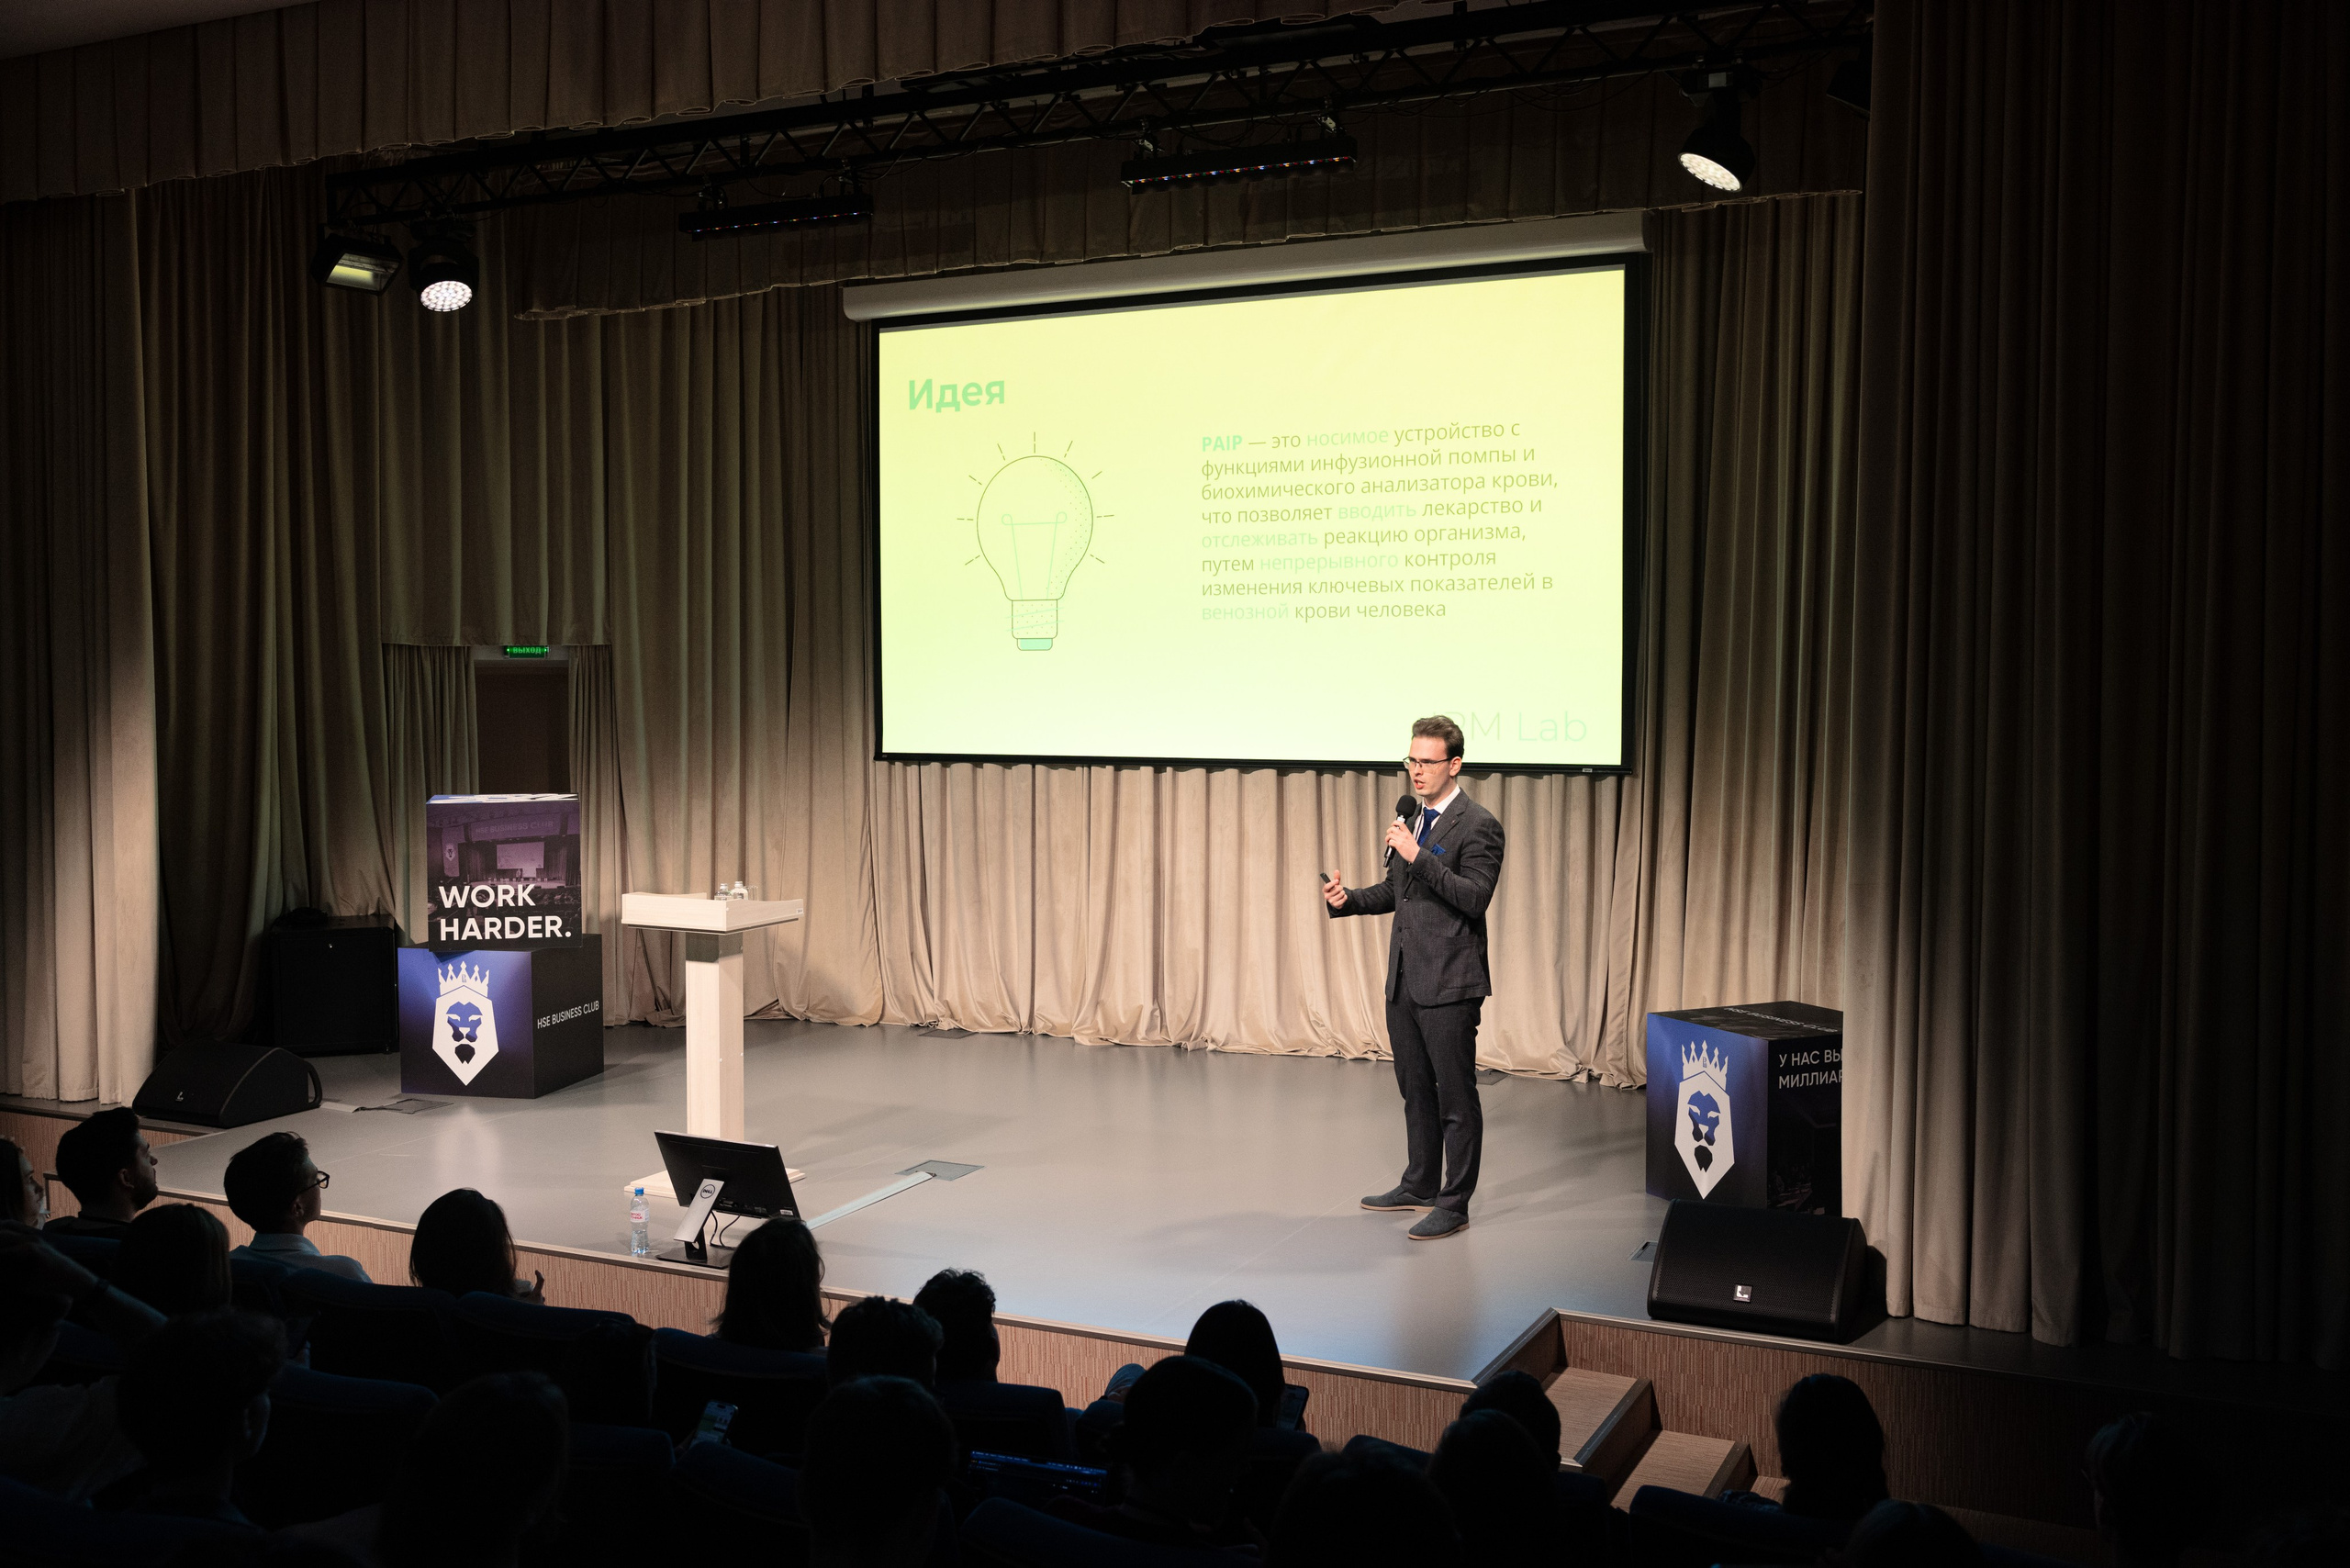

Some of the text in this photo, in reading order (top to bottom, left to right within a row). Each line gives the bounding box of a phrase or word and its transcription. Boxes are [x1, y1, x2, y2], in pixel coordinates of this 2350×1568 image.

[909, 378, 1004, 413] Идея
[1202, 435, 1243, 452] PAIP
[1271, 435, 1301, 449] это
[1307, 430, 1389, 446] носимое
[1394, 422, 1505, 447] устройство
[1511, 423, 1519, 436] с
[1202, 448, 1535, 480] функциями инфузионной помпы и
[1202, 474, 1557, 500] биохимического анализатора крови,
[1202, 499, 1541, 524] что позволяет вводить лекарство и
[1202, 526, 1526, 549] отслеживать реакцию организма,
[1203, 552, 1496, 577] путем непрерывного контроля
[1203, 573, 1553, 596] изменения ключевых показателей в
[1202, 603, 1446, 623] венозной крови человека
[512, 646, 542, 655] ВЫХОД
[1518, 711, 1587, 742] Lab
[438, 883, 536, 909] WORK
[440, 915, 573, 941] HARDER.
[537, 1000, 599, 1029] HSE BUSINESS CLUB
[1779, 1053, 1787, 1068] У
[1791, 1050, 1820, 1067] НАС
